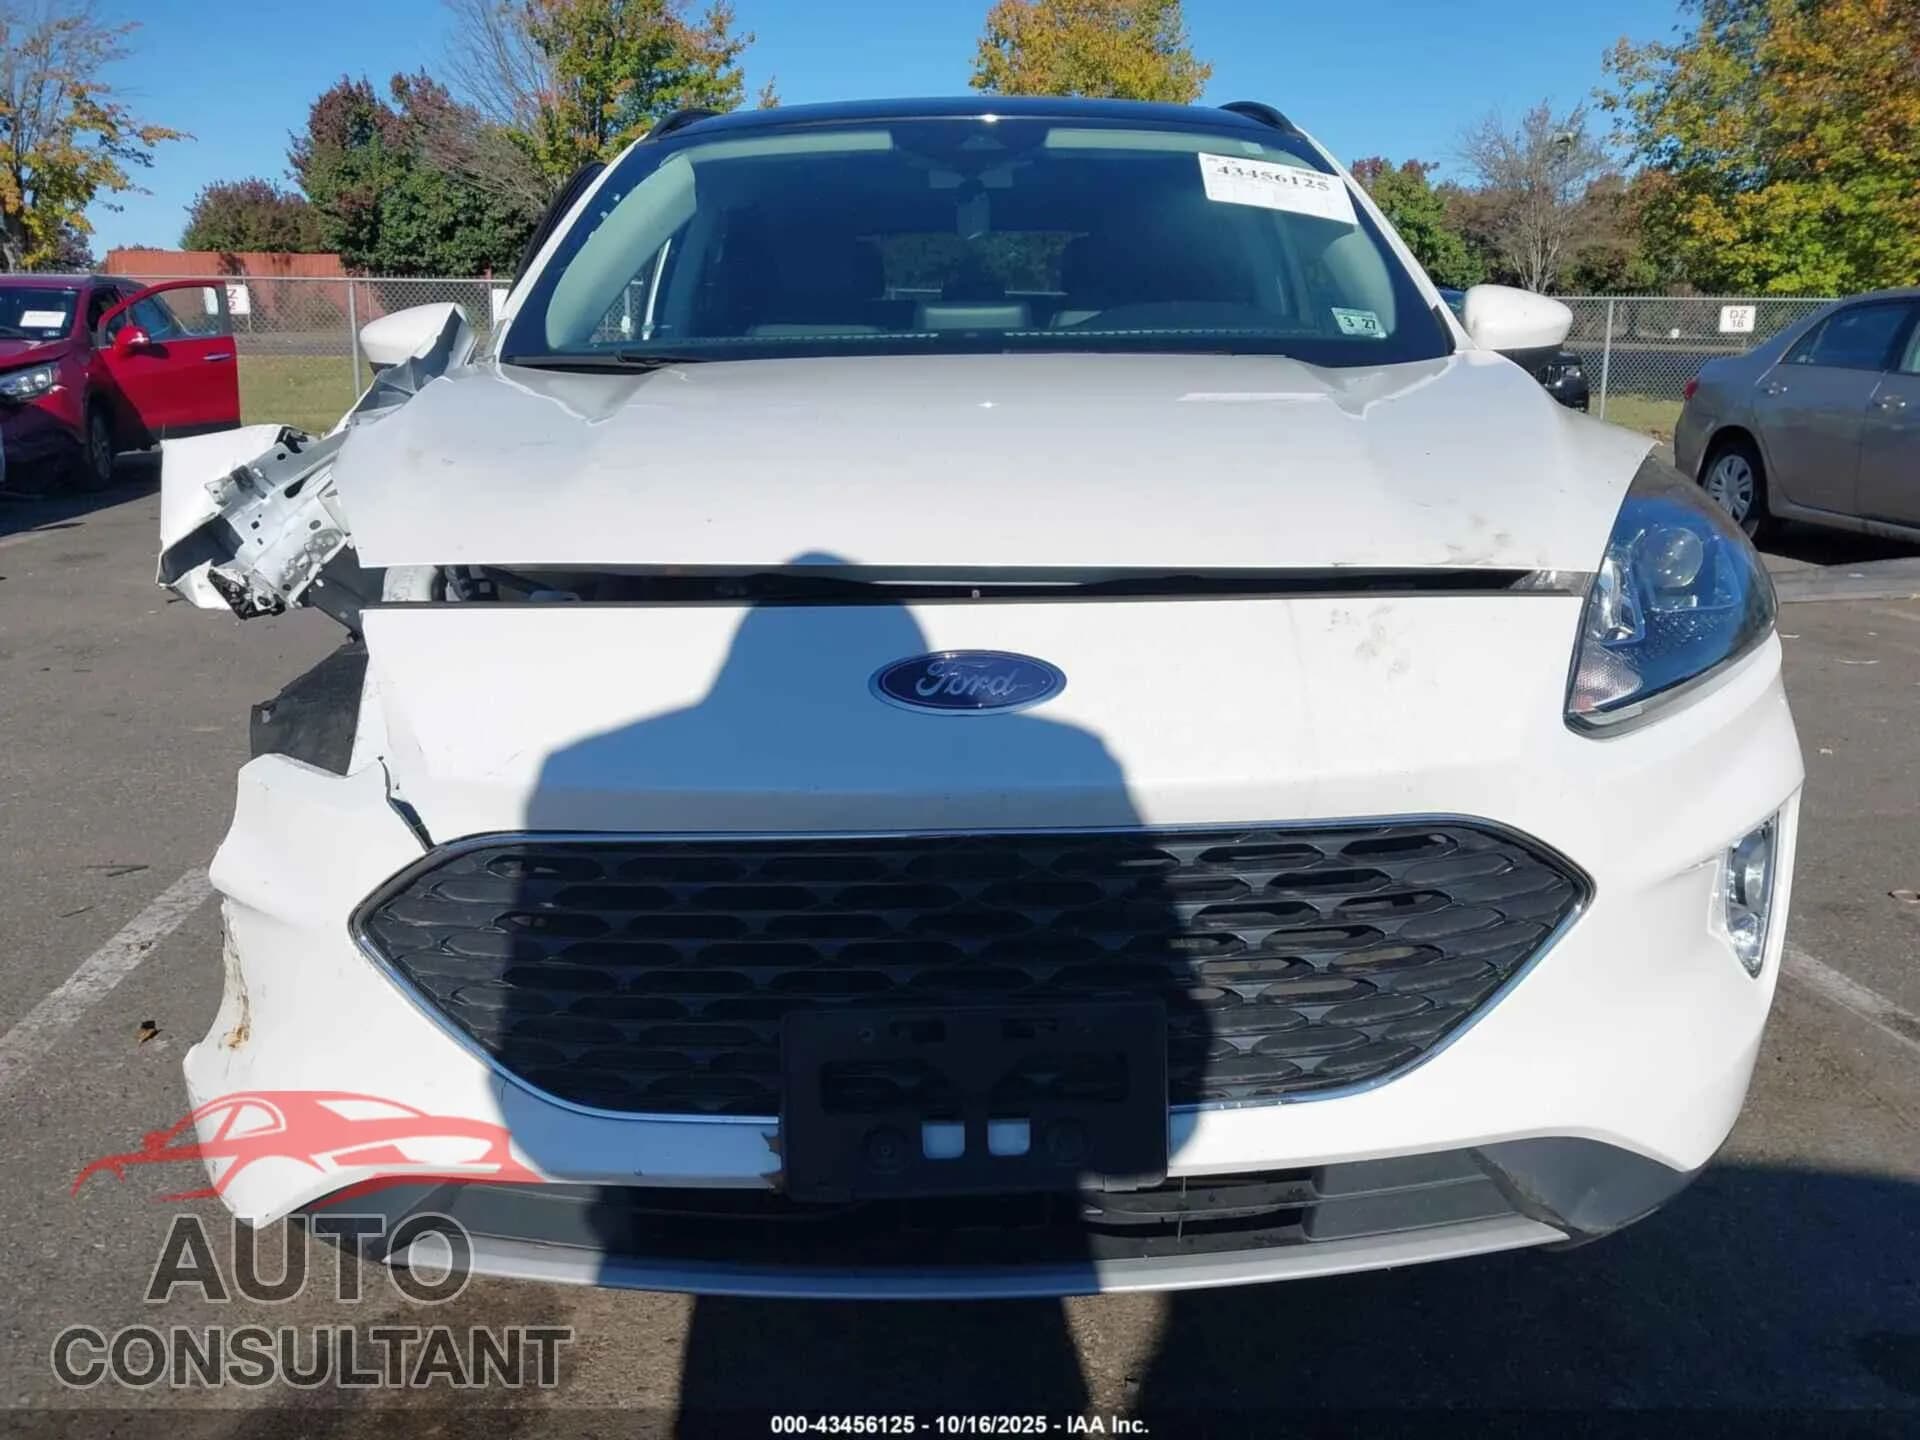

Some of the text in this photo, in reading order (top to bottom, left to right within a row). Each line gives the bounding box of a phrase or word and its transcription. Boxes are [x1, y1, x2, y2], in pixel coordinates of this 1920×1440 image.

[1216, 165, 1331, 193] 43456125
[1343, 316, 1376, 330] 3 27
[1729, 309, 1748, 319] DZ
[915, 661, 1032, 697] Ford
